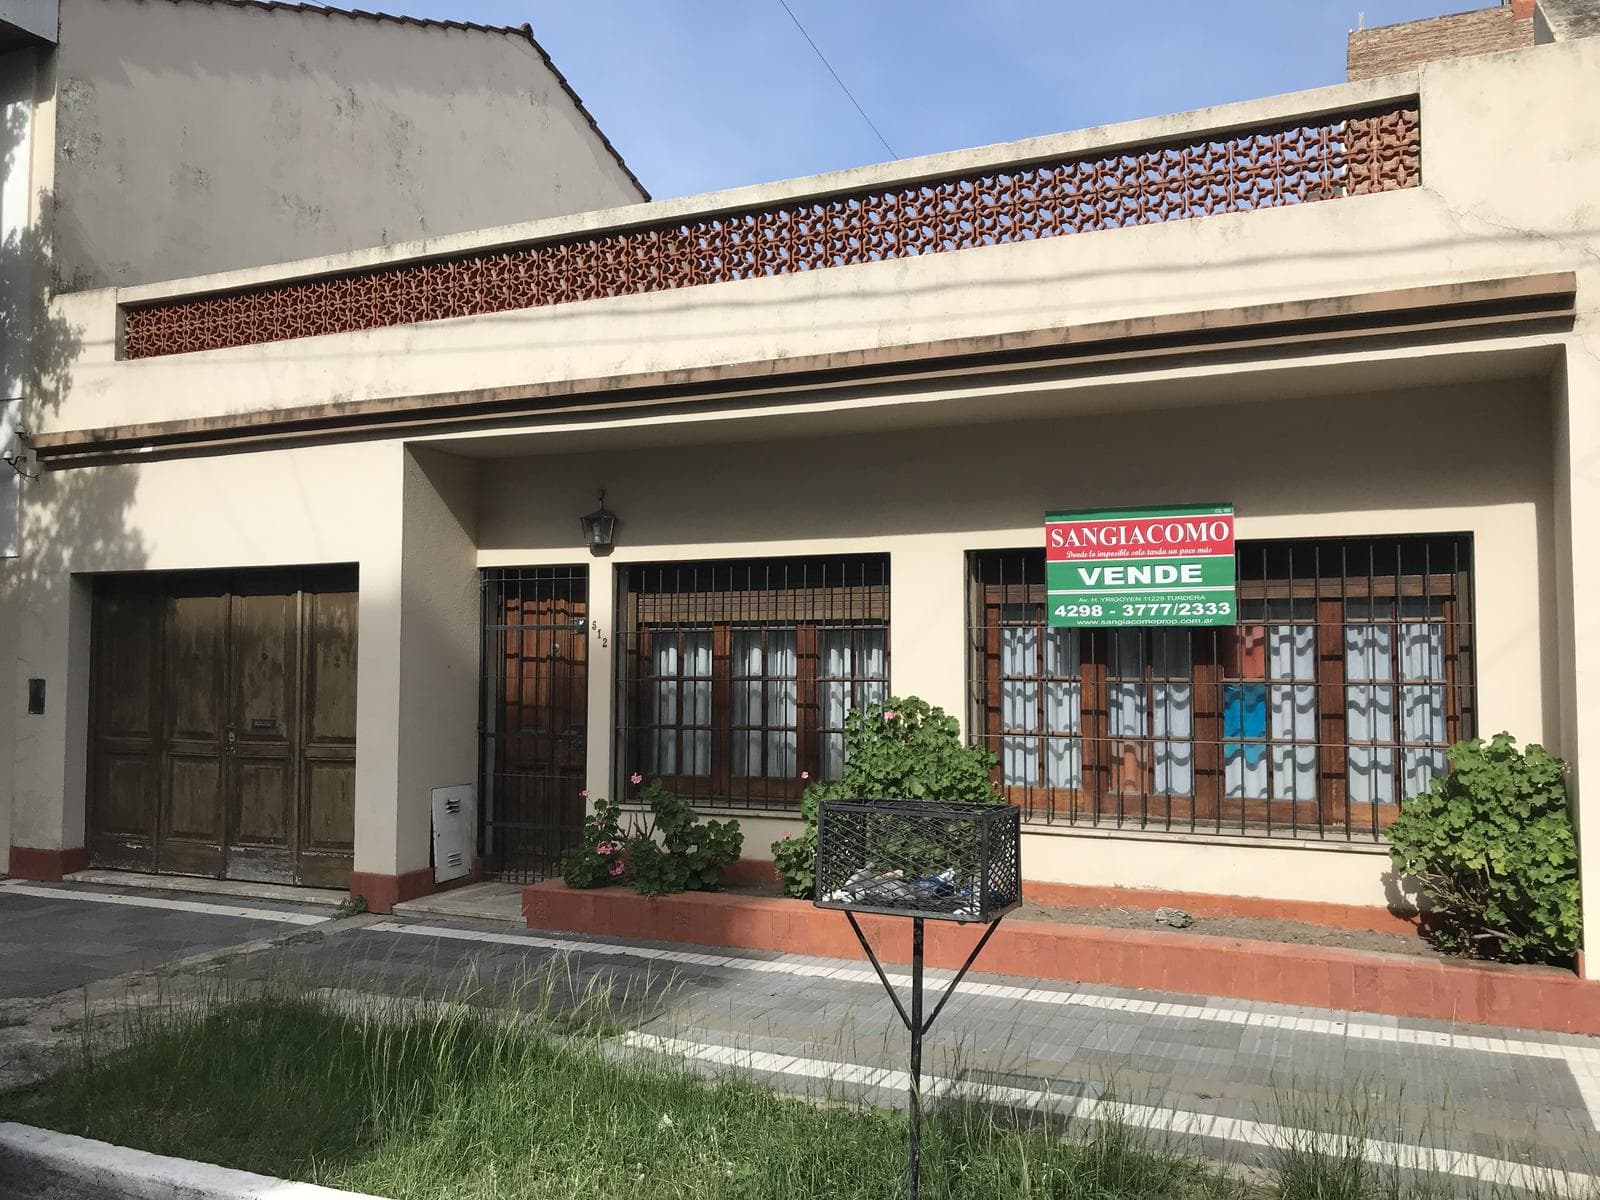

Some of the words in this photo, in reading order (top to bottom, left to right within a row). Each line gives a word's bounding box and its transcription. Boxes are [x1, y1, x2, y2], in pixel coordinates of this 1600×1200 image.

[1051, 521, 1230, 547] SANGIACOMO
[1066, 550, 1088, 559] Donde
[1097, 548, 1130, 559] imposible
[1146, 547, 1167, 556] tarda
[1179, 547, 1196, 556] poco
[1077, 564, 1203, 586] VENDE
[1100, 595, 1142, 603] YRIGOYEN
[1054, 604, 1104, 618] 4298
[1122, 601, 1232, 617] 3777/2333
[1076, 618, 1214, 626] www.sangiacomoprop.com.ar
[591, 620, 609, 649] 512
